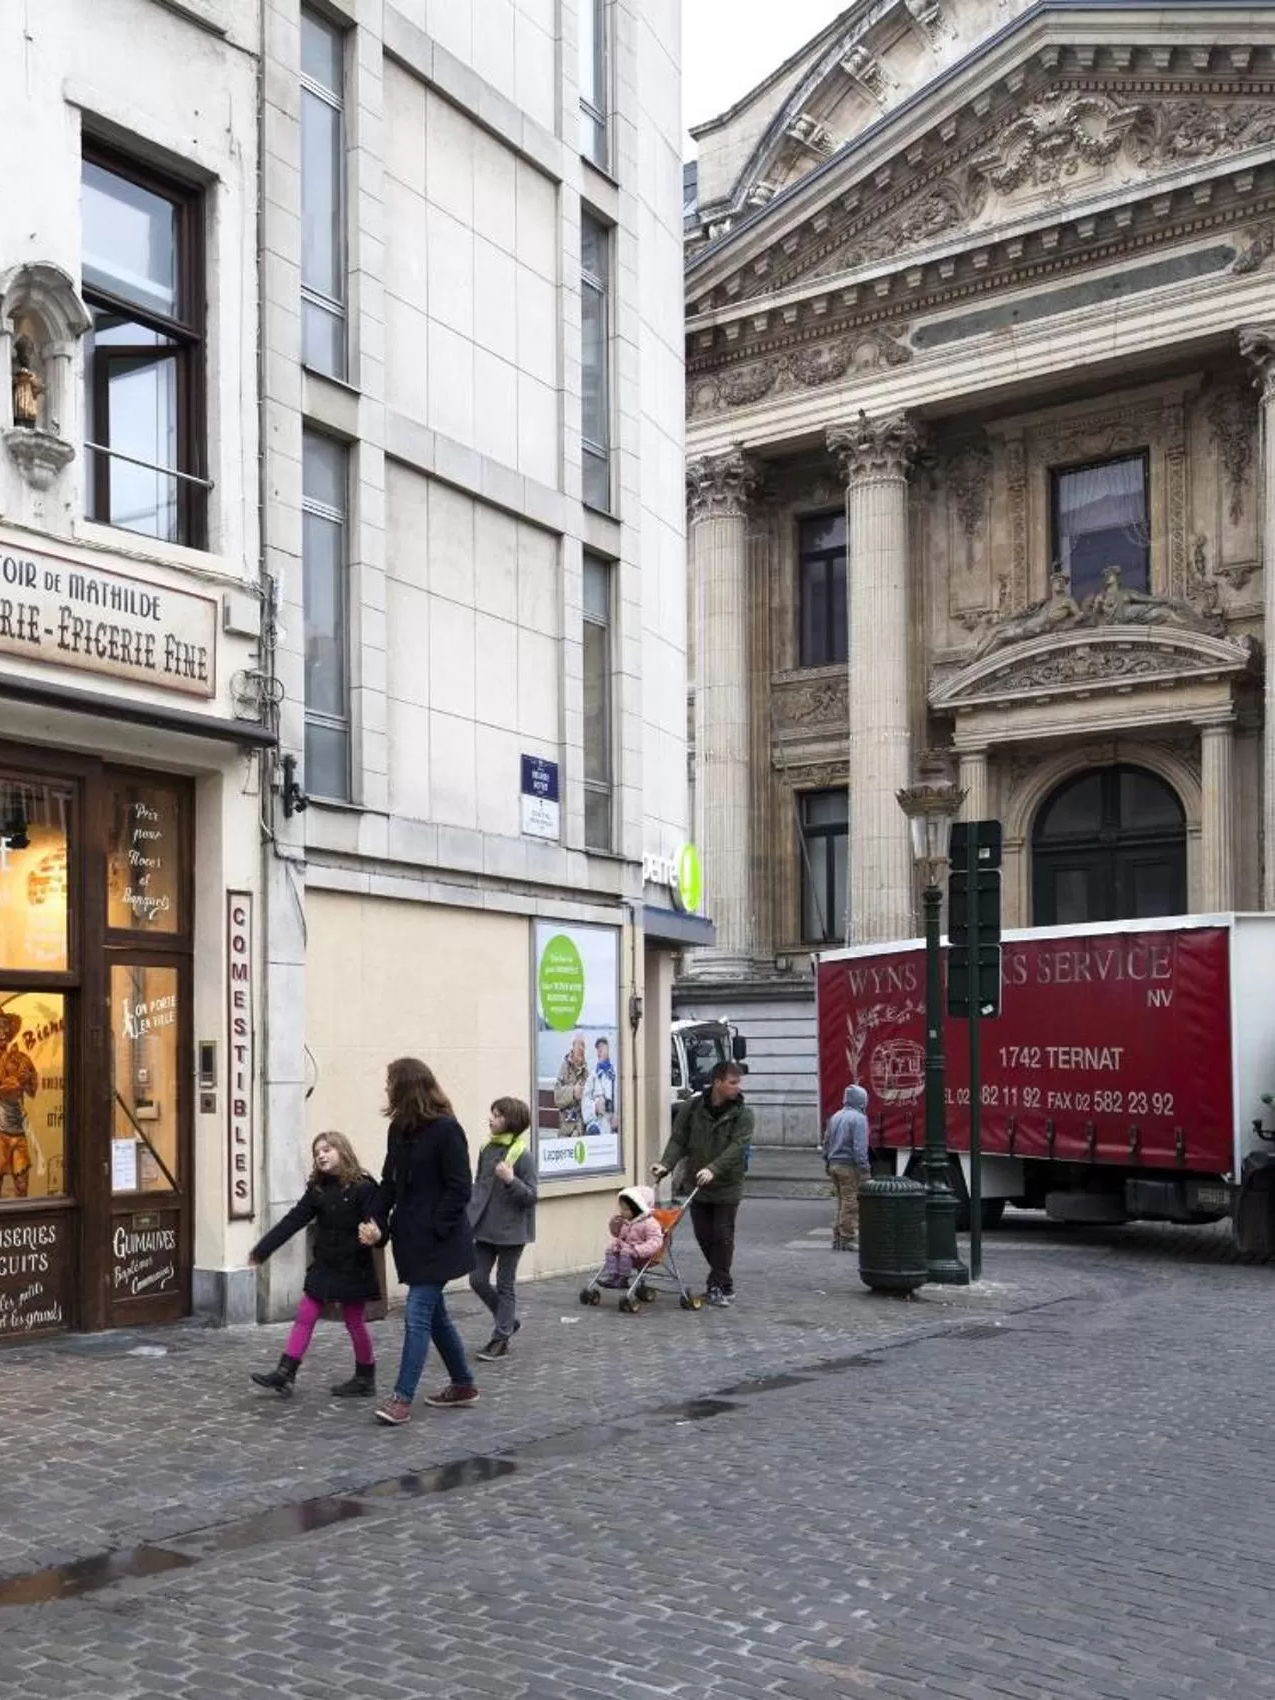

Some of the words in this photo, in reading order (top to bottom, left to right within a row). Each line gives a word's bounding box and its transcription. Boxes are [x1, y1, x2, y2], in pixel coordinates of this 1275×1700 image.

[44, 571, 61, 593] DE
[69, 573, 161, 621] MATHILDE
[58, 605, 156, 669] EPICERIE
[164, 633, 208, 681] FINE
[848, 964, 917, 997] WYNS
[1036, 946, 1173, 984] SERVICE
[1147, 989, 1173, 1008] NV
[231, 907, 249, 1199] COMESTIBLES
[999, 1047, 1041, 1069] 1742
[1046, 1047, 1123, 1070] TERNAT
[957, 1088, 970, 1105] 02
[979, 1085, 999, 1105] 82
[1002, 1086, 1018, 1107] 11
[1023, 1087, 1041, 1108] 92
[1048, 1092, 1072, 1109] FAX
[1075, 1094, 1091, 1111] 02
[1094, 1090, 1123, 1112] 582
[1128, 1092, 1148, 1114] 23
[1152, 1093, 1174, 1116] 92
[113, 1227, 175, 1259] GUIMAUVES
